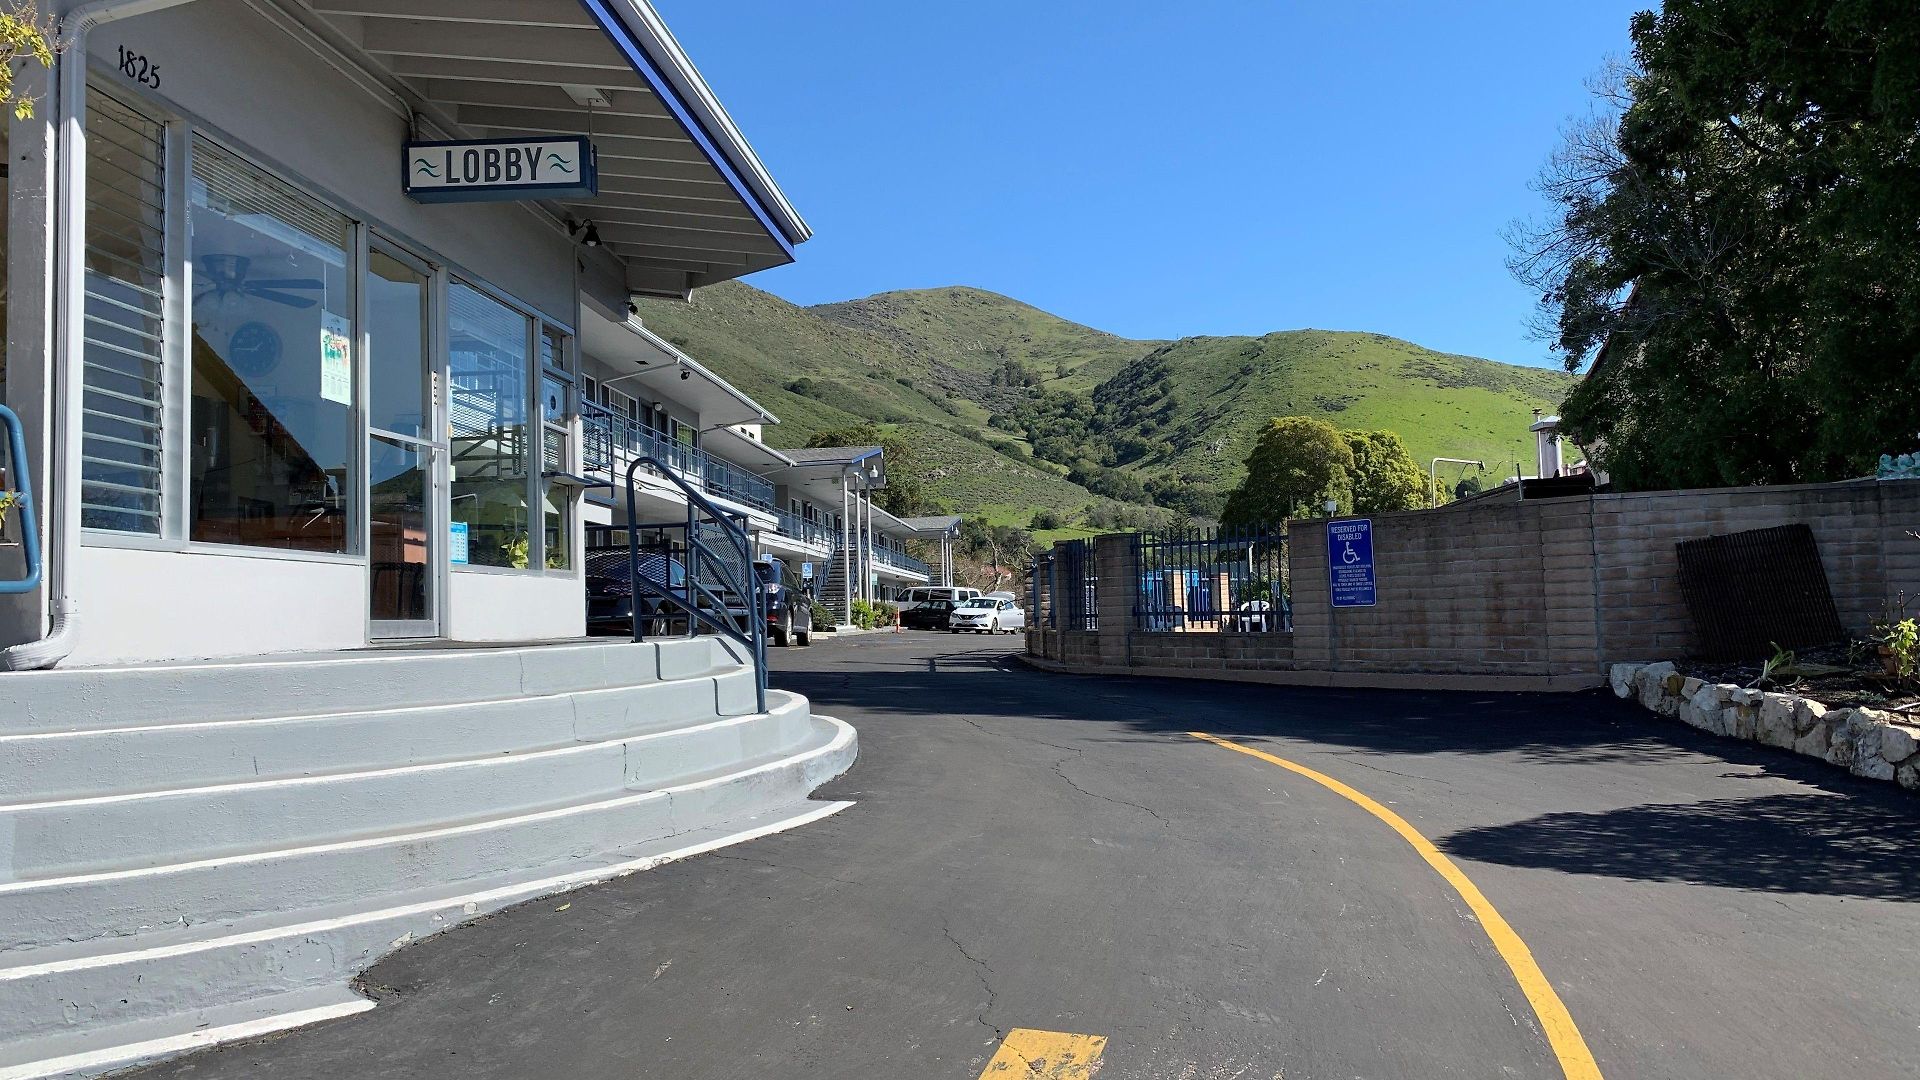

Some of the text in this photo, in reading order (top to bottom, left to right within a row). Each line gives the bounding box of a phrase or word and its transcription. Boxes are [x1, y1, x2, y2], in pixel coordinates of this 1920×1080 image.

[118, 45, 160, 89] 1825
[445, 147, 543, 184] LOBBY
[1330, 524, 1368, 534] RESERVED FOR
[1337, 532, 1362, 541] DISABLED
